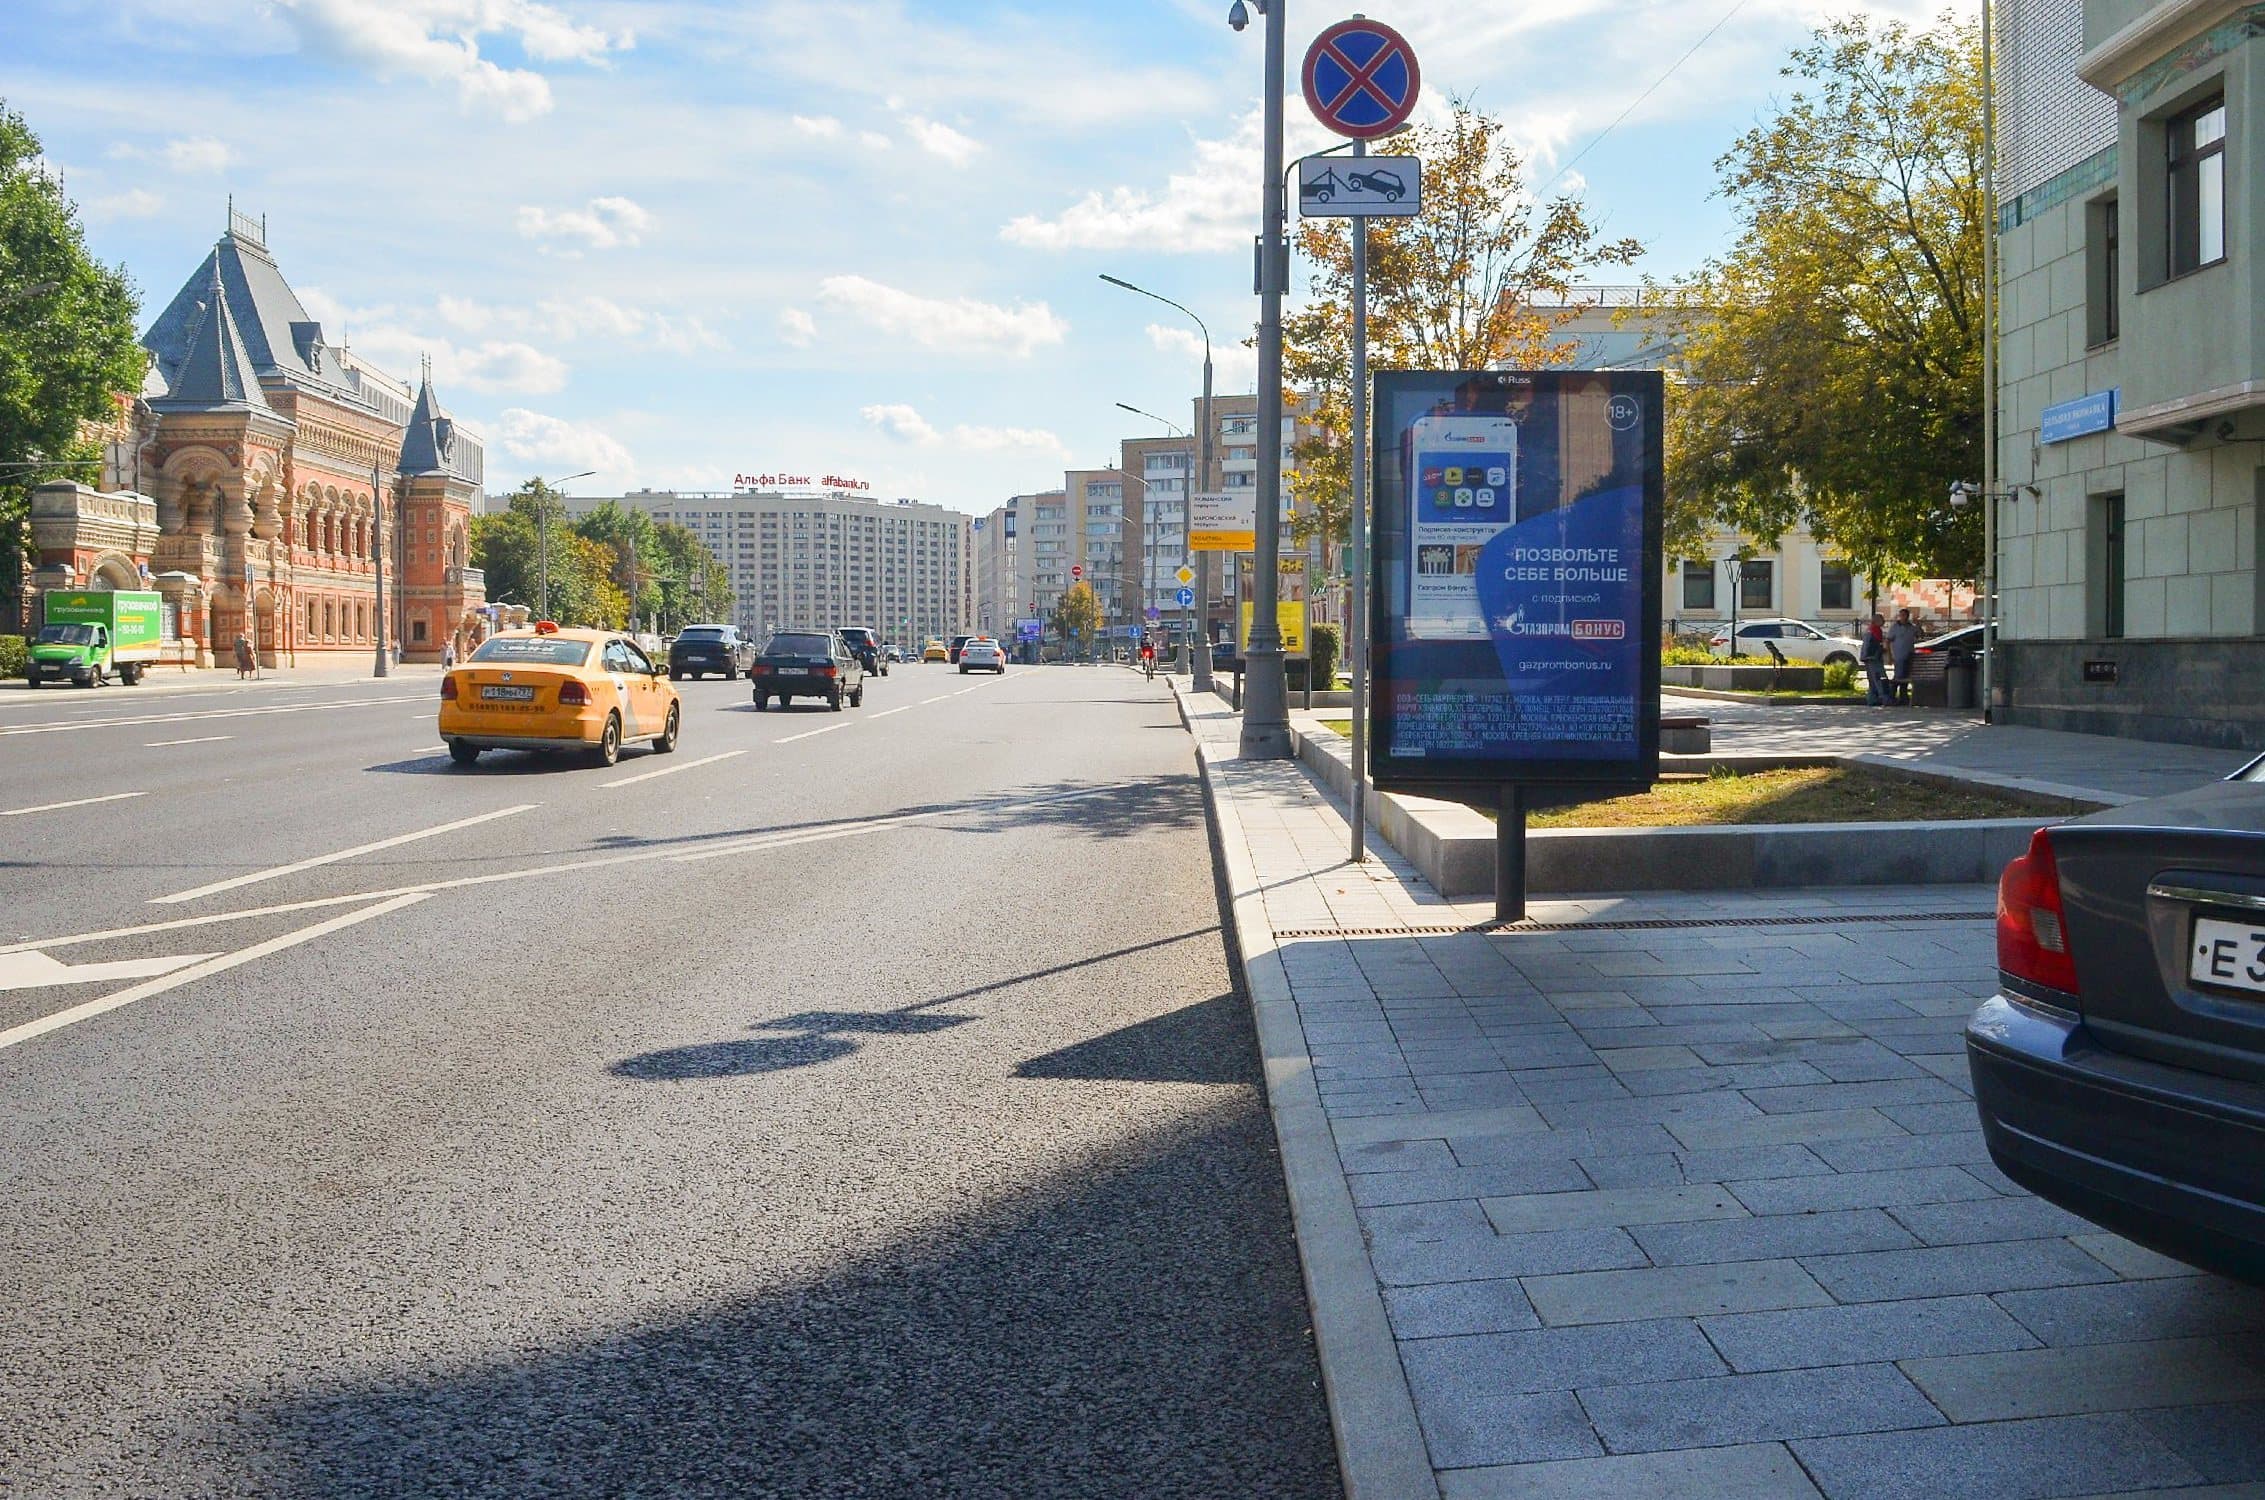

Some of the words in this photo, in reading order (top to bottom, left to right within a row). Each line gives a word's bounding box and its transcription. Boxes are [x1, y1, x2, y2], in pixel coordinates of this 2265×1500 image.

[1507, 375, 1532, 385] Russ
[1609, 405, 1633, 419] 18+
[734, 473, 776, 487] Альфа
[778, 473, 811, 486] Банк
[821, 475, 870, 490] alfabank.ru
[1515, 548, 1619, 562] ПОЗВОЛЬТЕ
[1504, 567, 1549, 581] СЕБЕ
[1554, 567, 1629, 582] БОЛЬШЕ
[1541, 592, 1601, 604] подпиской
[1525, 623, 1570, 636] ГАЗПРОМ
[1574, 623, 1622, 636] БОНУС
[1518, 660, 1612, 672] gazprombonus.ru
